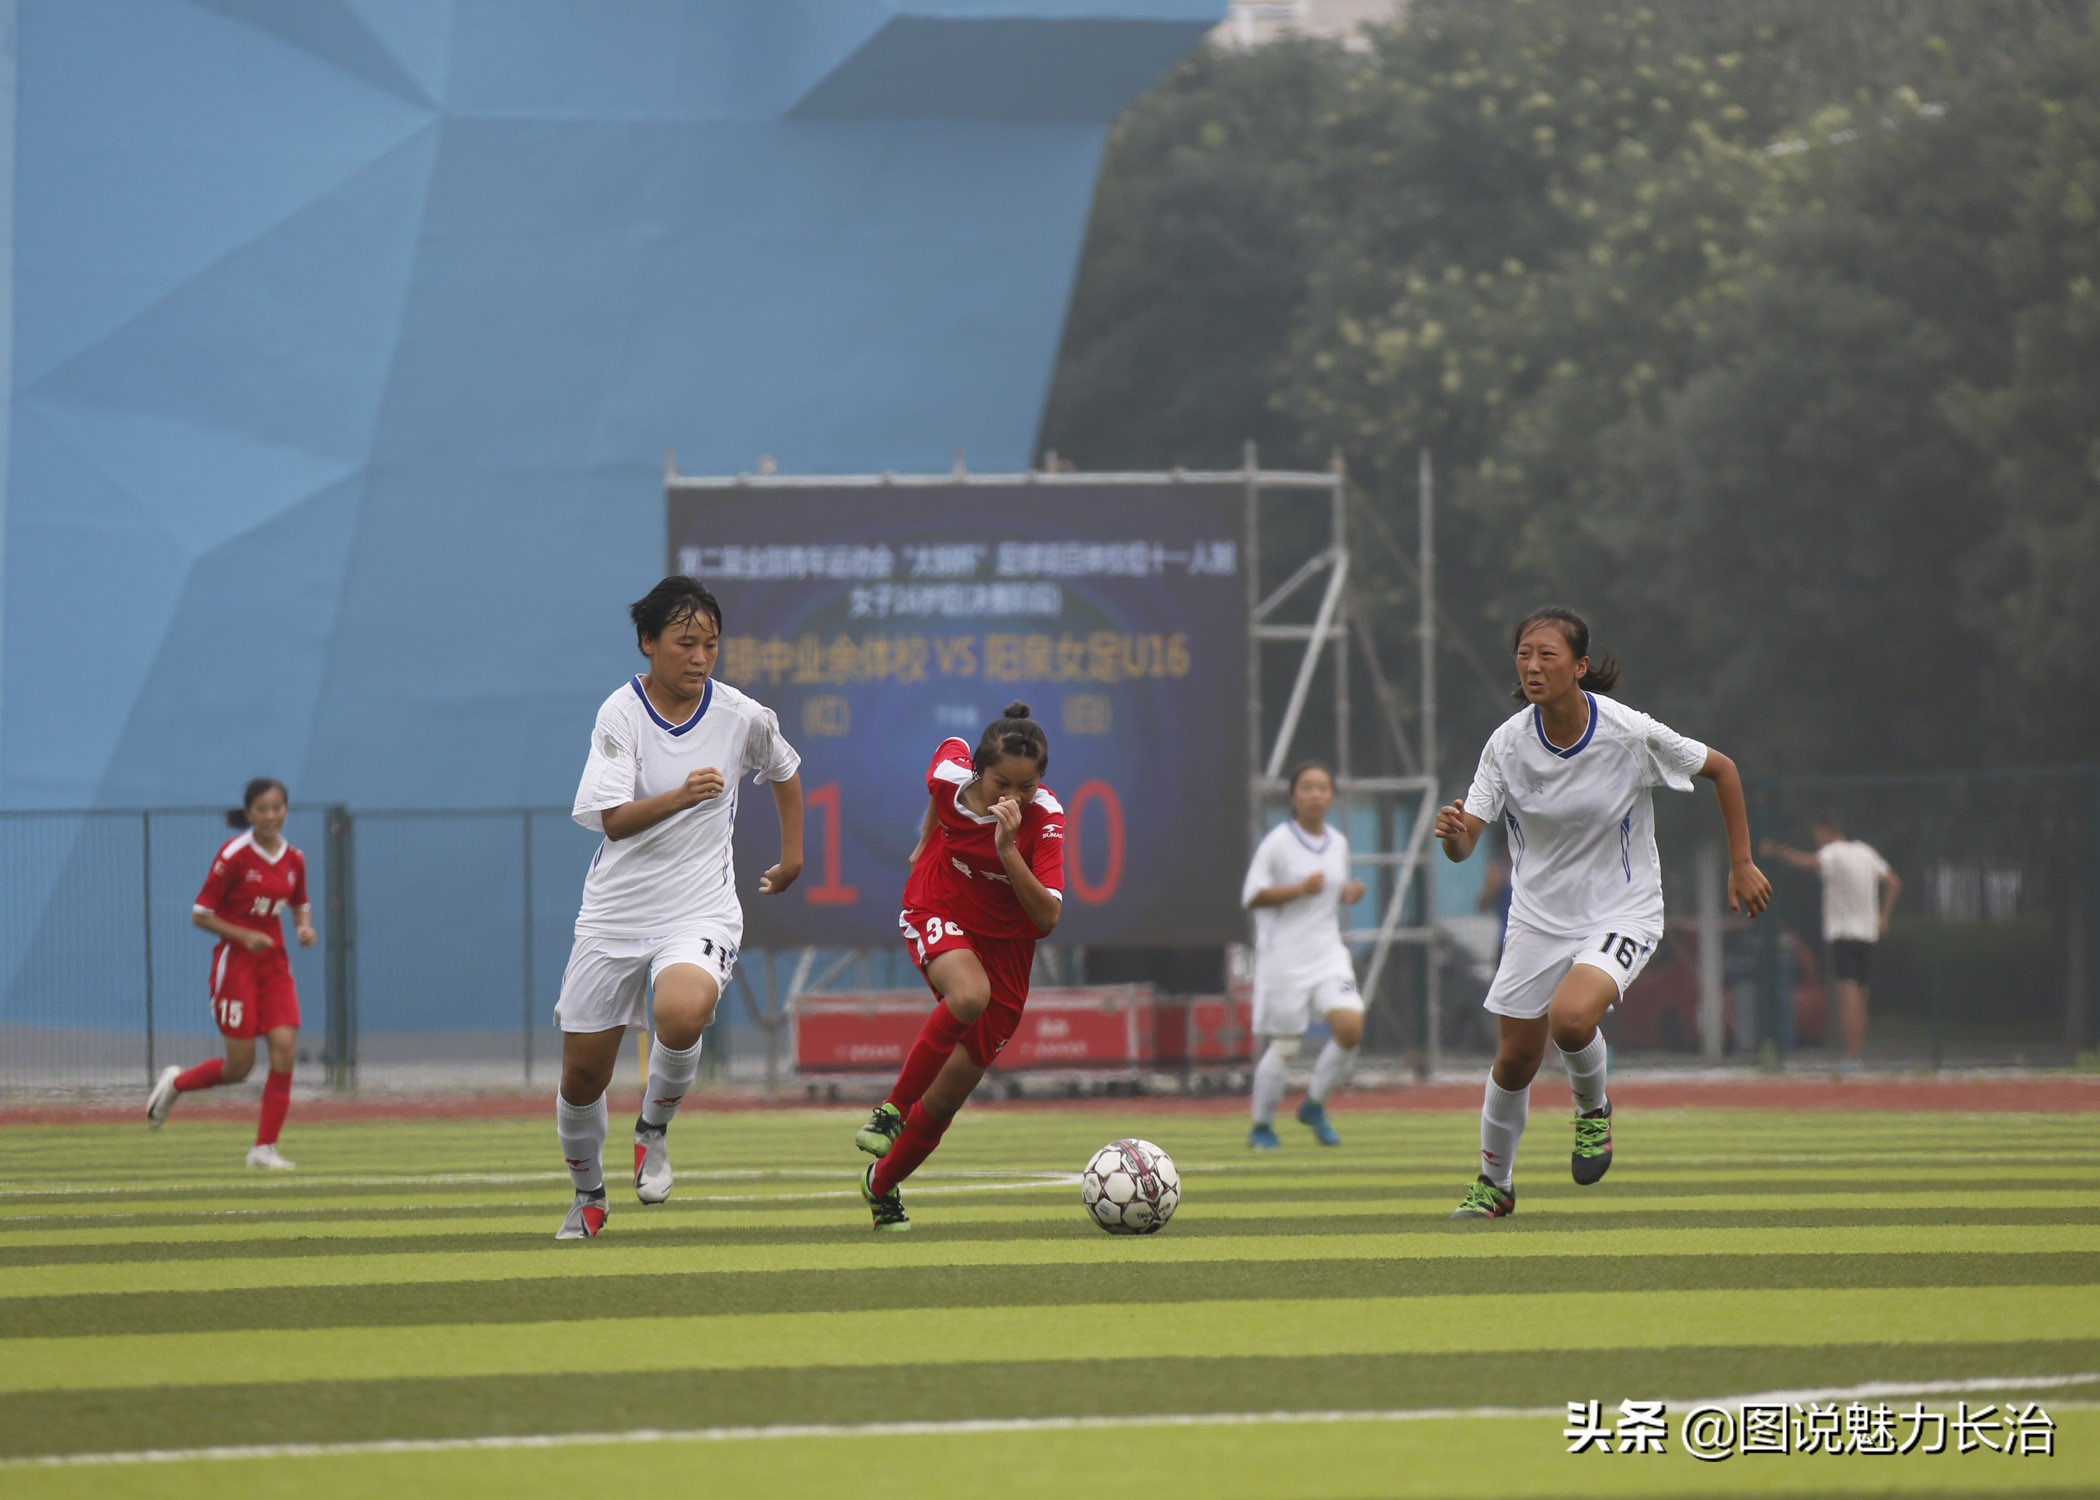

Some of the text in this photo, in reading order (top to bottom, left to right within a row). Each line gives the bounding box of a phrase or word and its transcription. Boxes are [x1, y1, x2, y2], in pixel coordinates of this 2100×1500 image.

[933, 636, 976, 677] VS
[805, 782, 859, 906] 1
[1068, 779, 1125, 906] 0
[1599, 932, 1637, 971] 16
[219, 998, 244, 1029] 15
